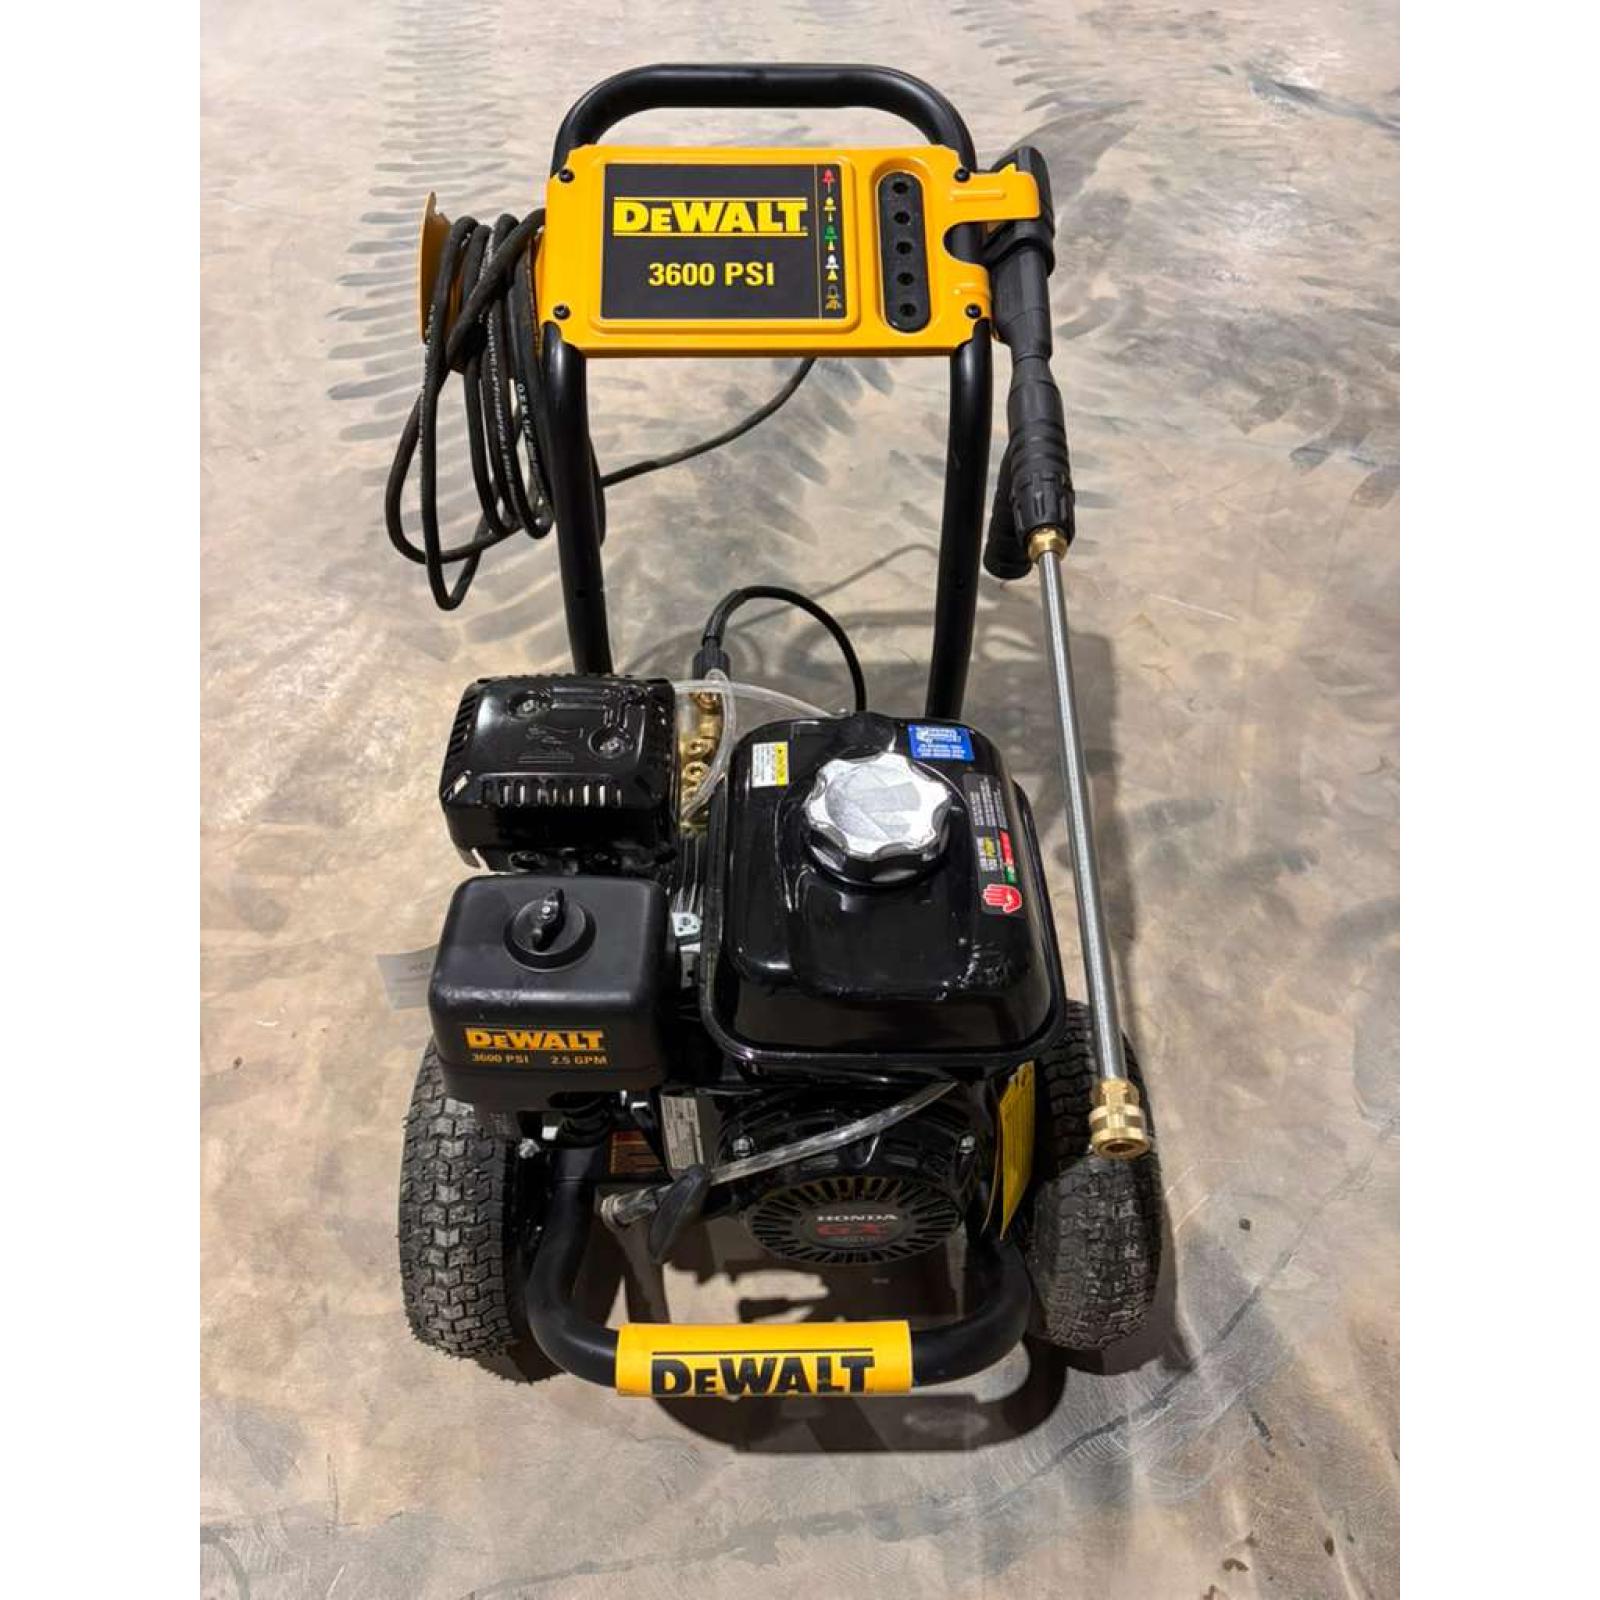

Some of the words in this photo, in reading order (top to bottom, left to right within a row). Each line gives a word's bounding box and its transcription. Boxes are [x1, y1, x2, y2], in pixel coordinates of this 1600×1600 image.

[648, 262, 715, 286] 3600
[724, 262, 775, 286] PSI
[472, 1053, 502, 1063] 3600
[506, 1054, 529, 1064] PSI
[551, 1055, 570, 1065] 2.5
[575, 1055, 608, 1065] GPM
[816, 1213, 898, 1222] HONDA
